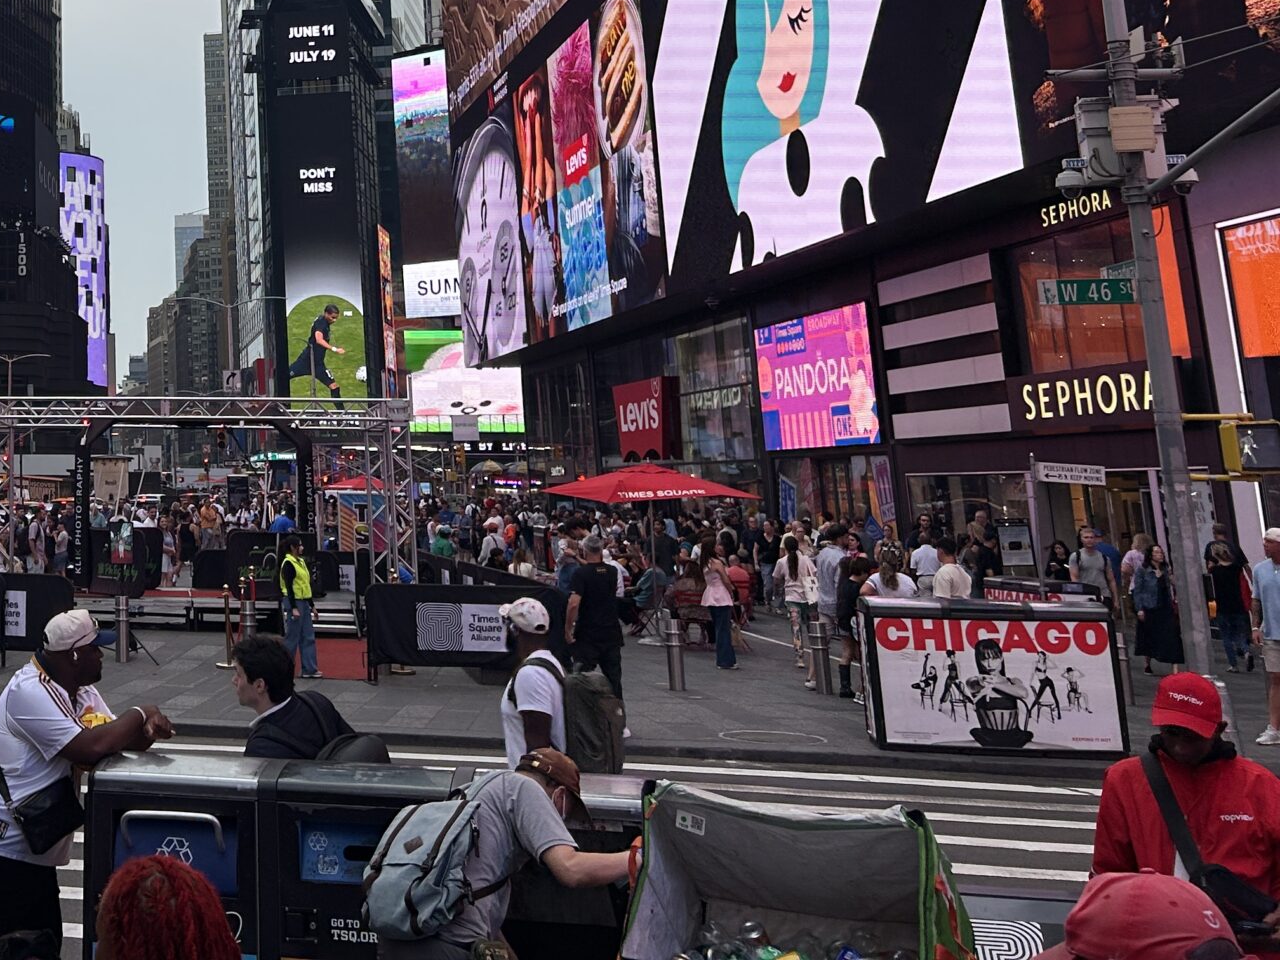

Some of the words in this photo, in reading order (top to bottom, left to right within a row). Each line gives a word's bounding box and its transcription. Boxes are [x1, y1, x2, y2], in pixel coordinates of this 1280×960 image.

[288, 26, 320, 39] JUNE
[321, 24, 335, 36] 11
[288, 50, 321, 64] JULY
[321, 49, 336, 61] 19
[566, 145, 588, 176] Levi's
[1065, 158, 1086, 168] NYPD
[38, 159, 58, 200] GUCCI
[299, 167, 336, 180] DON'T
[303, 182, 333, 193] MISS
[564, 193, 596, 230] summer
[1040, 189, 1112, 228] SEPHORA
[18, 232, 27, 277] 1500
[610, 276, 628, 294] Square
[1060, 283, 1077, 303] W
[1087, 282, 1112, 302] 46
[1120, 282, 1133, 294] St
[774, 356, 851, 400] PANDORA
[619, 397, 660, 433] Levi's
[1043, 464, 1075, 474] PEDESTRIAN
[1075, 466, 1089, 475] FLOW
[1089, 467, 1102, 476] ZONE
[1070, 474, 1082, 482] KEEP
[1083, 474, 1103, 483] MOVING
[75, 456, 84, 541] PHOTOGRAPHY
[617, 490, 655, 499] TIMES
[657, 489, 706, 498] SQUARE
[74, 544, 82, 575] KLIK
[470, 613, 500, 623] Times
[468, 623, 503, 634] Square
[470, 634, 501, 642] Alliance
[875, 617, 1109, 656] CHICAGO
[330, 918, 345, 929] GO
[346, 918, 360, 929] TO
[330, 929, 379, 944] TSQ.OR
